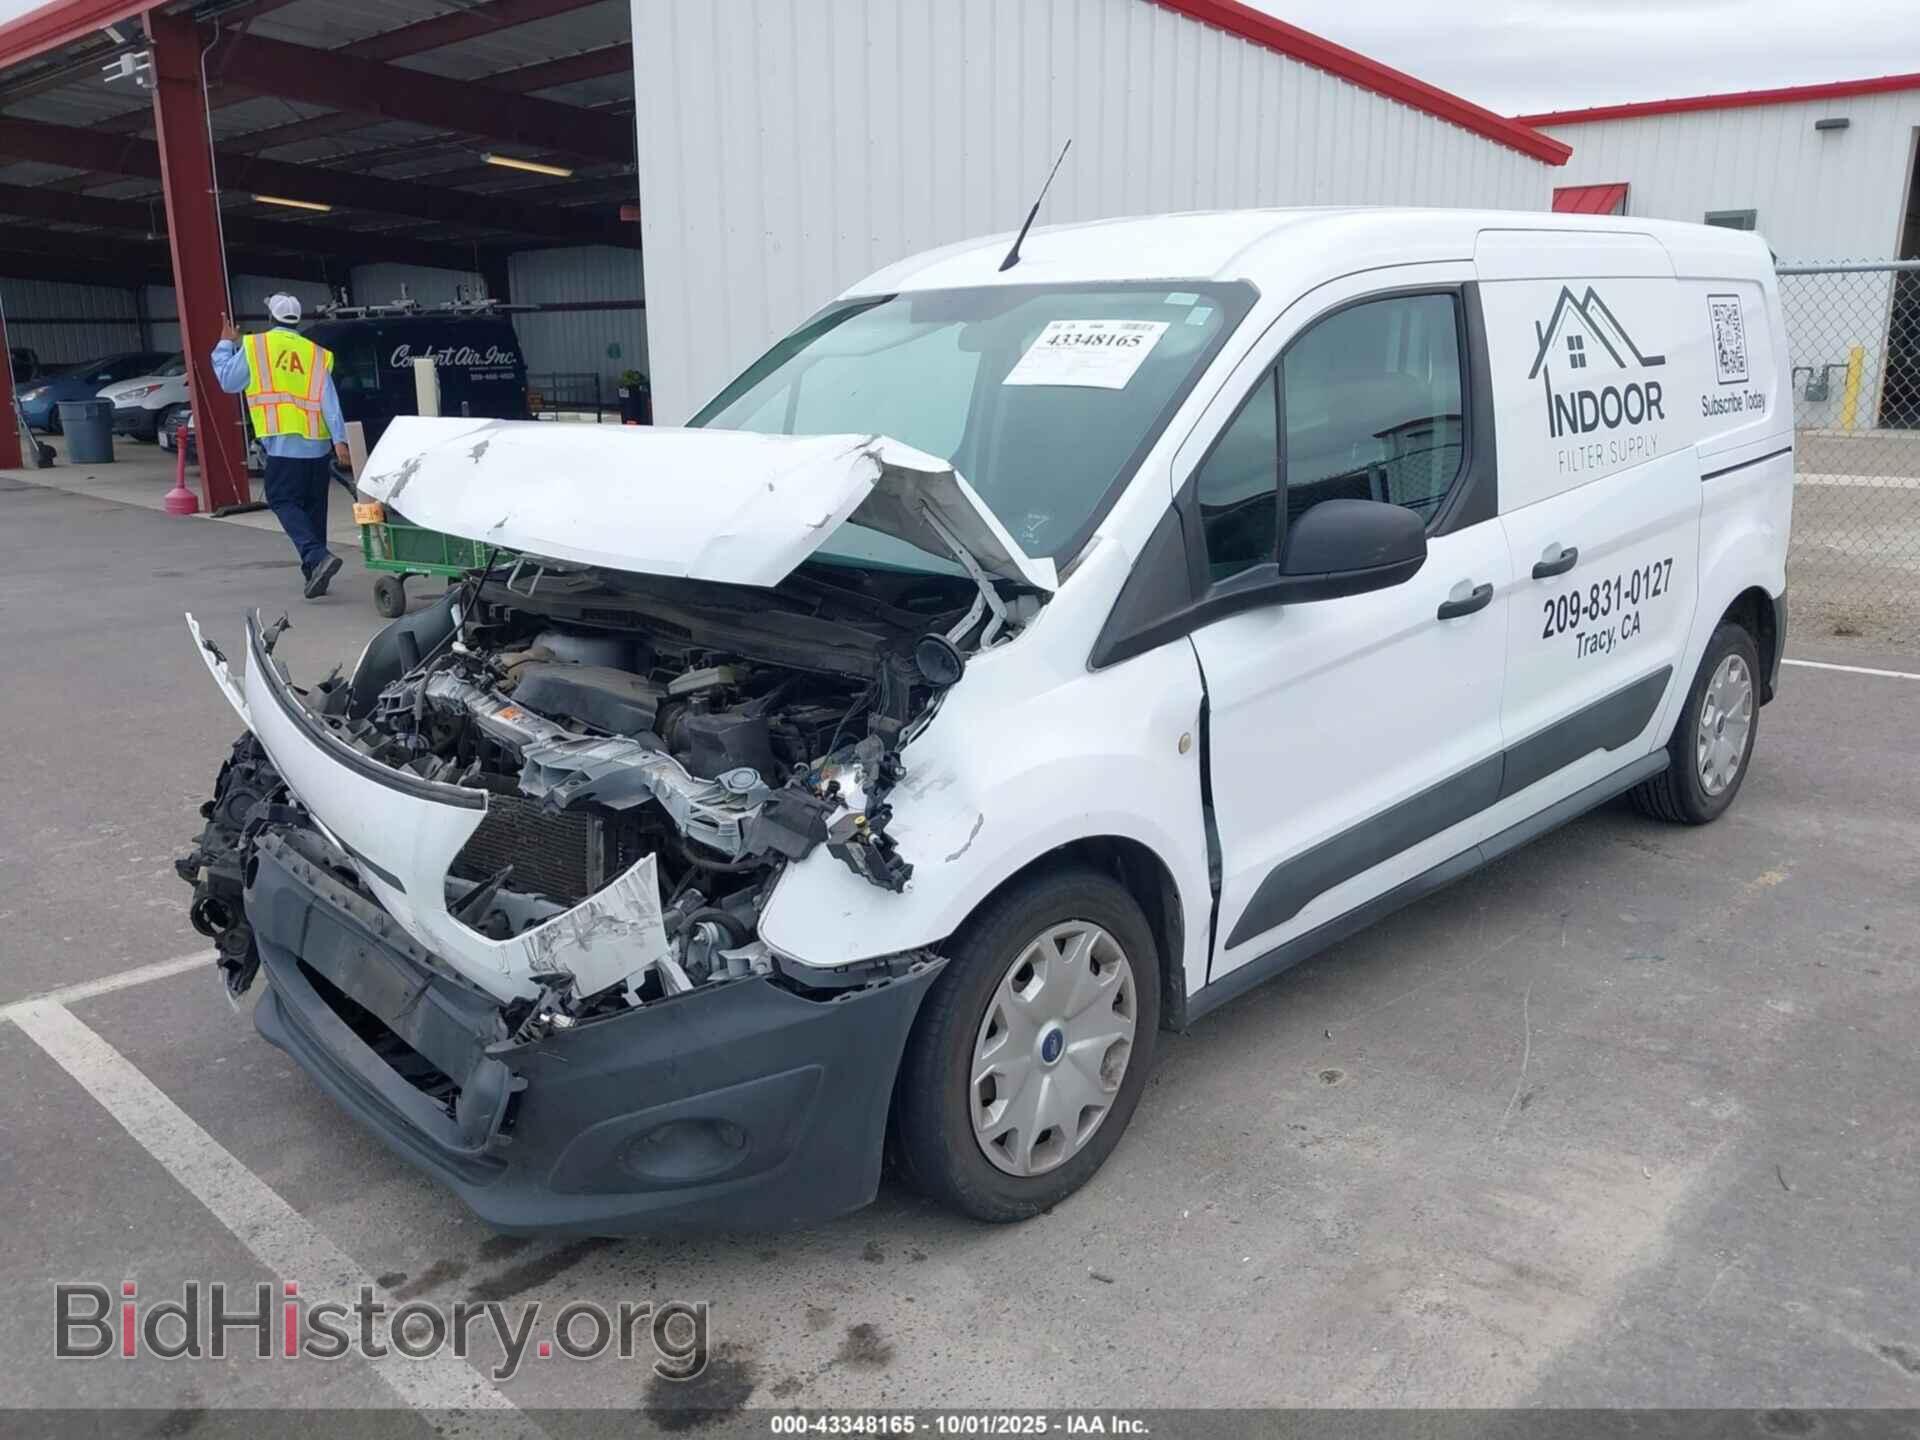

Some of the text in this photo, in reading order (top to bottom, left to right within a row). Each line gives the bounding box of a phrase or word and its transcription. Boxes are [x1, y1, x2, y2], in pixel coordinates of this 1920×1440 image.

[1046, 333, 1144, 348] 43348165
[1544, 364, 1665, 438] INDOOR
[1702, 388, 1766, 417] Subscribe Today
[1558, 433, 1658, 475] FILTER SUPPLY
[1543, 557, 1673, 639] 209-831-0127
[1576, 610, 1641, 659] Tracy, CA
